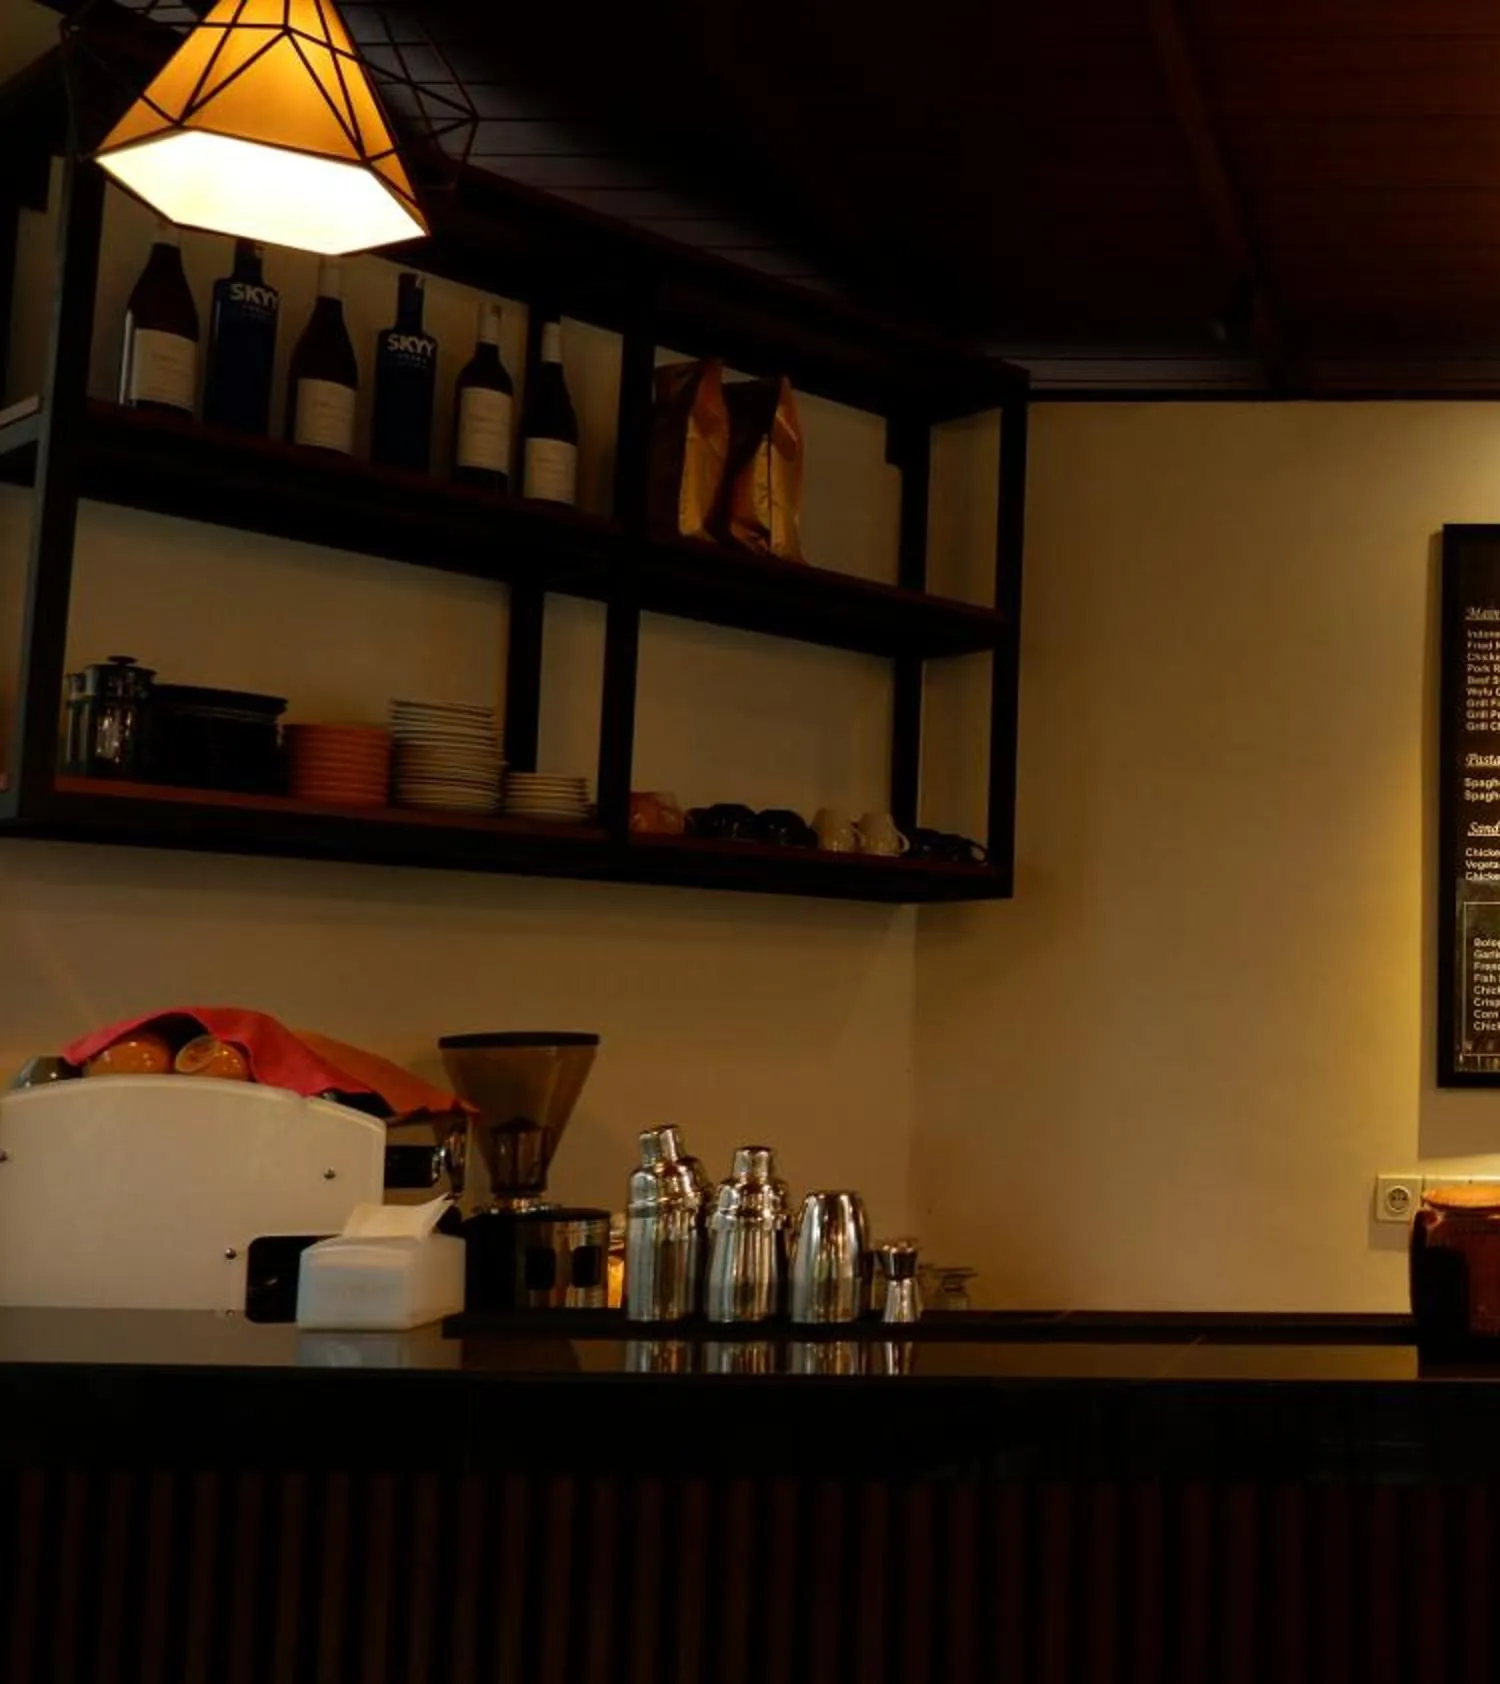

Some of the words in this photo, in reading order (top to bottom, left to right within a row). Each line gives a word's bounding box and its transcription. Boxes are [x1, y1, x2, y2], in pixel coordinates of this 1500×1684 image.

[230, 283, 279, 309] SKYY
[386, 333, 435, 357] SKYY
[1465, 607, 1500, 620] Main
[1467, 641, 1493, 650] Fried
[1467, 664, 1490, 673] Pork
[1466, 699, 1488, 708] Grill
[1466, 710, 1488, 719] Grill
[1466, 723, 1488, 731] Grill
[1473, 973, 1496, 983] Fish
[1473, 1009, 1499, 1019] Corn
